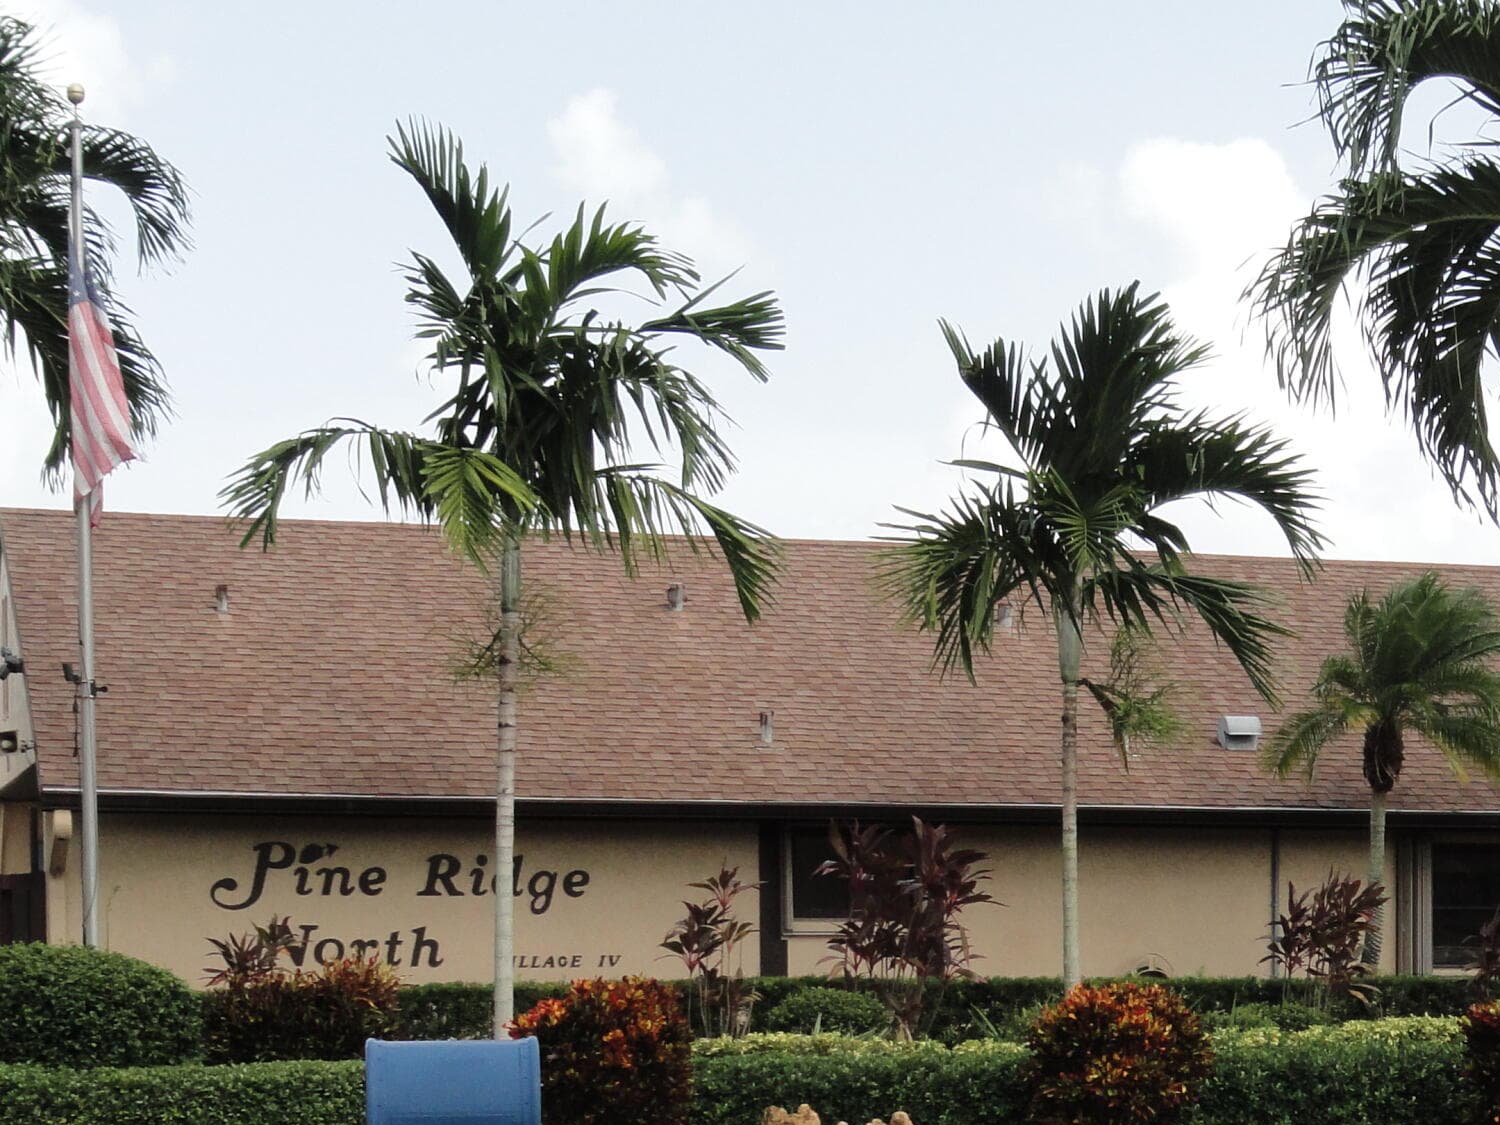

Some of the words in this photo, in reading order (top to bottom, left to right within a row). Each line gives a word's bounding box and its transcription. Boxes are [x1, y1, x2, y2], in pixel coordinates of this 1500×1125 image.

[210, 841, 387, 910] Pine
[417, 853, 590, 915] Ridge
[272, 924, 444, 968] North
[512, 955, 582, 968] ILLAGE
[598, 955, 622, 967] IV
